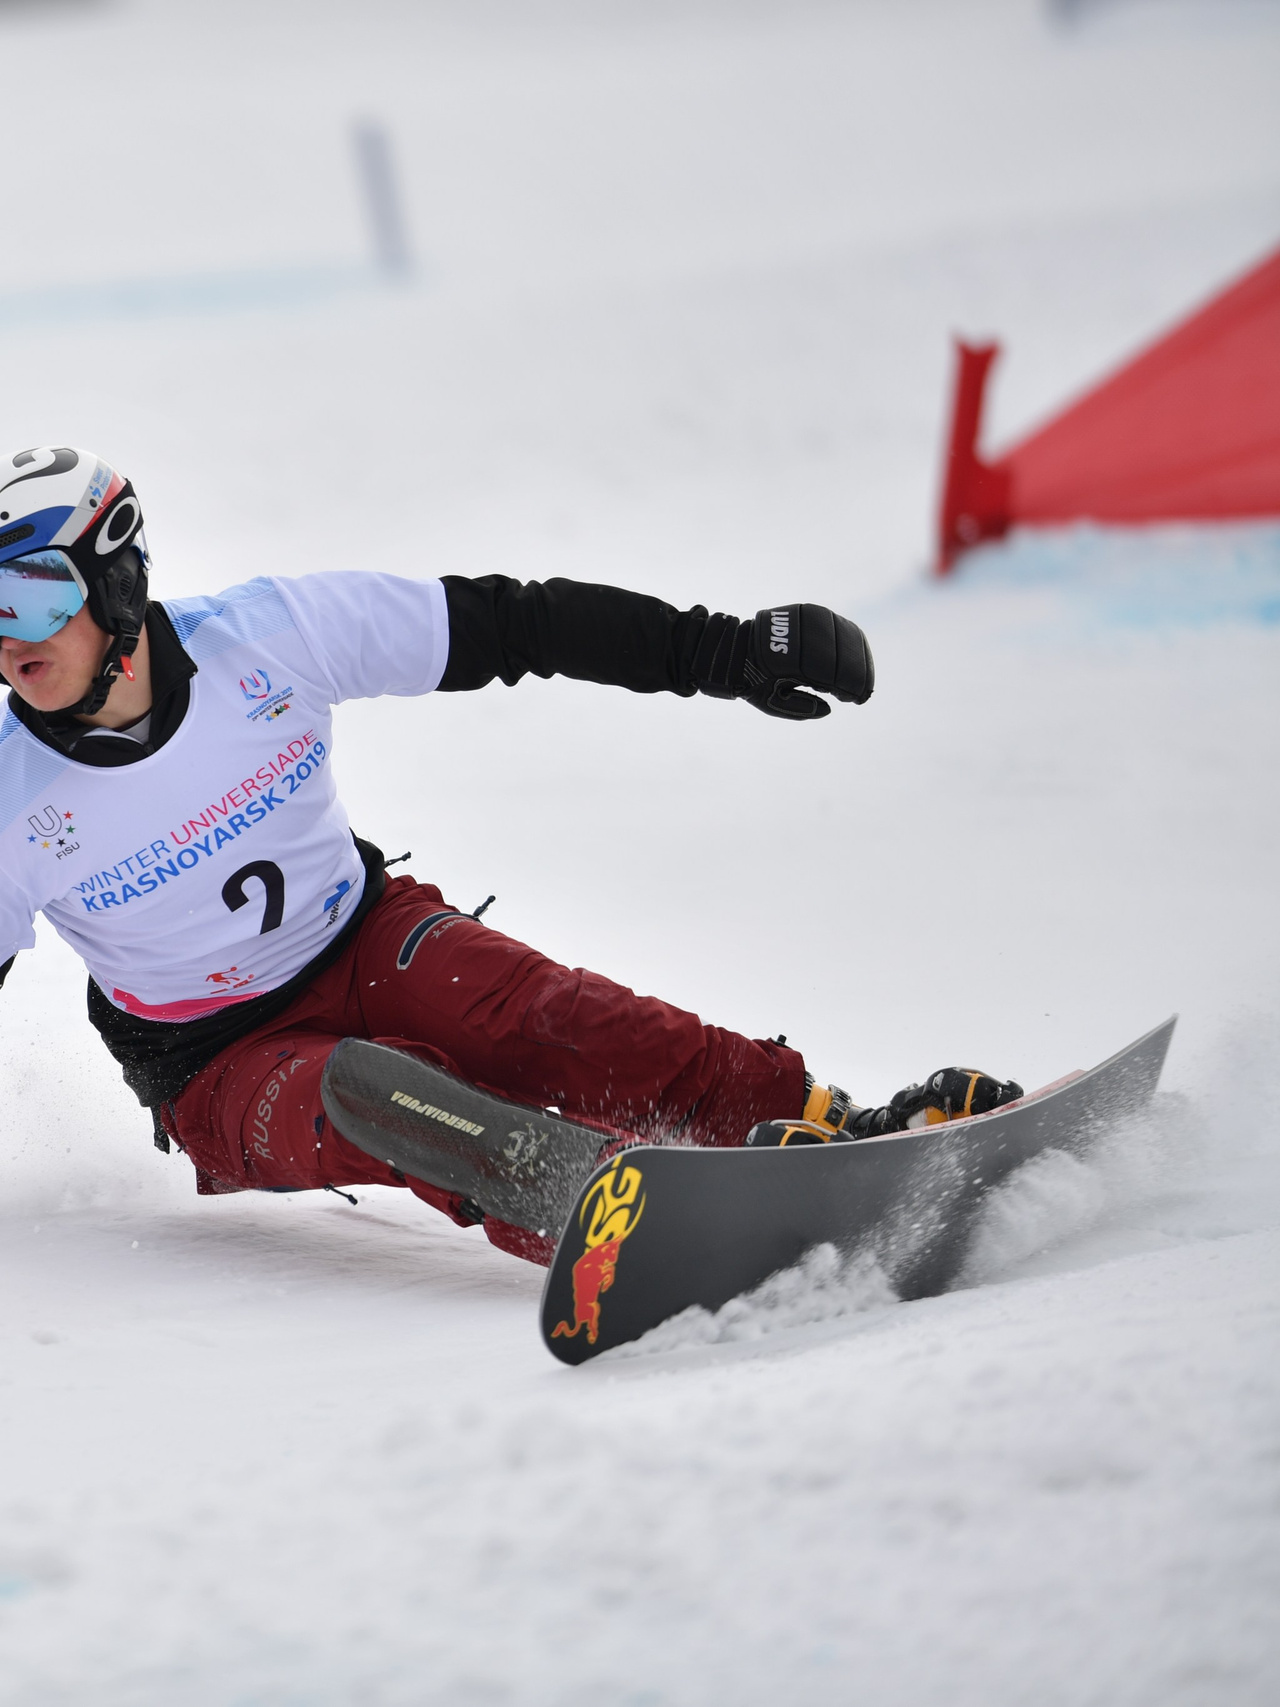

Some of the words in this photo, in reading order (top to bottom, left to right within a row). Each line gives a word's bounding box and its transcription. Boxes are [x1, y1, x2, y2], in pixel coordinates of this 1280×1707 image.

[770, 611, 789, 654] LUDIS
[246, 693, 280, 719] KRASNOYARSK
[280, 686, 292, 696] 2019
[71, 839, 171, 894] WINTER
[170, 729, 318, 845] UNIVERSIADE
[81, 787, 286, 912] KRASNOYARSK
[281, 741, 327, 794] 2019
[55, 841, 80, 860] FISU
[253, 1059, 308, 1160] RUSSIA
[390, 1091, 486, 1136] ENERGIAPURA
